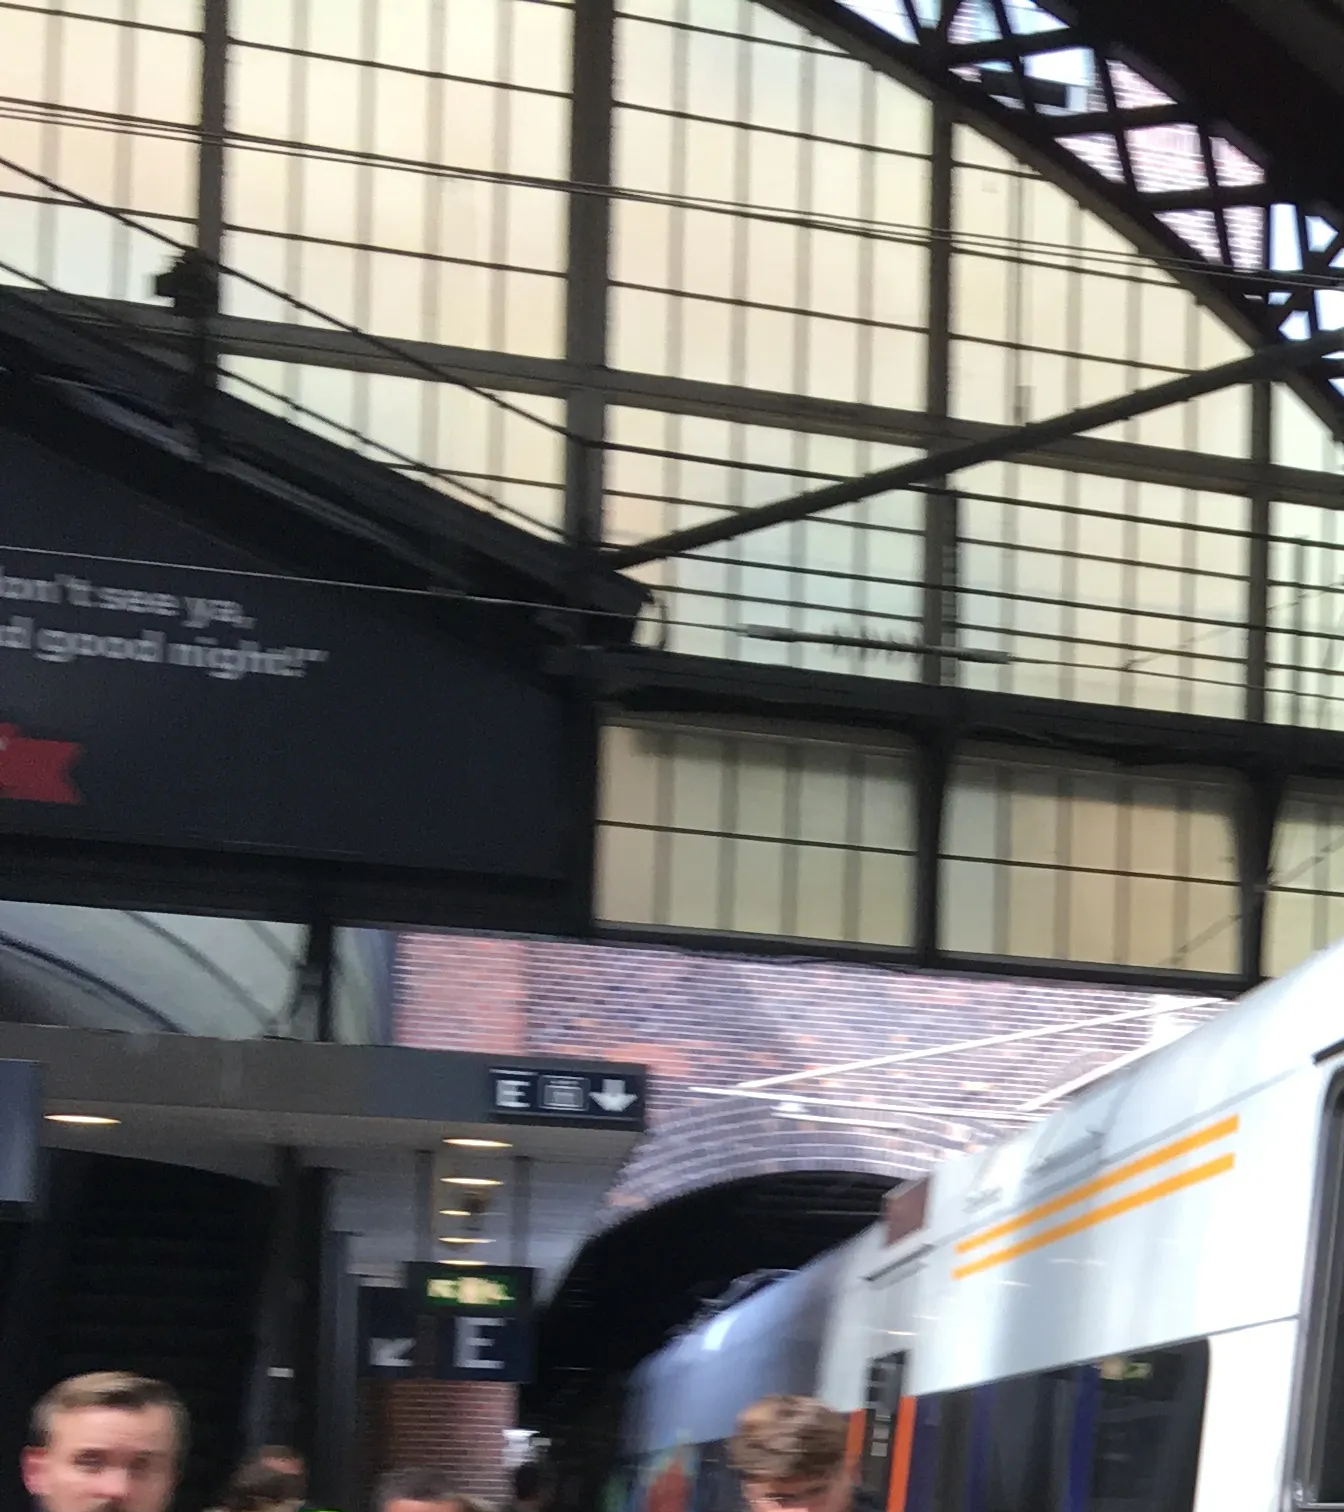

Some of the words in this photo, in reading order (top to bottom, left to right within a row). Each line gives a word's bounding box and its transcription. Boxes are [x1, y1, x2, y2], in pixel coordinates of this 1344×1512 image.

[0, 566, 92, 607] on't
[97, 587, 180, 617] see
[34, 628, 165, 662] good
[495, 1079, 531, 1108] E
[453, 1316, 507, 1370] E
